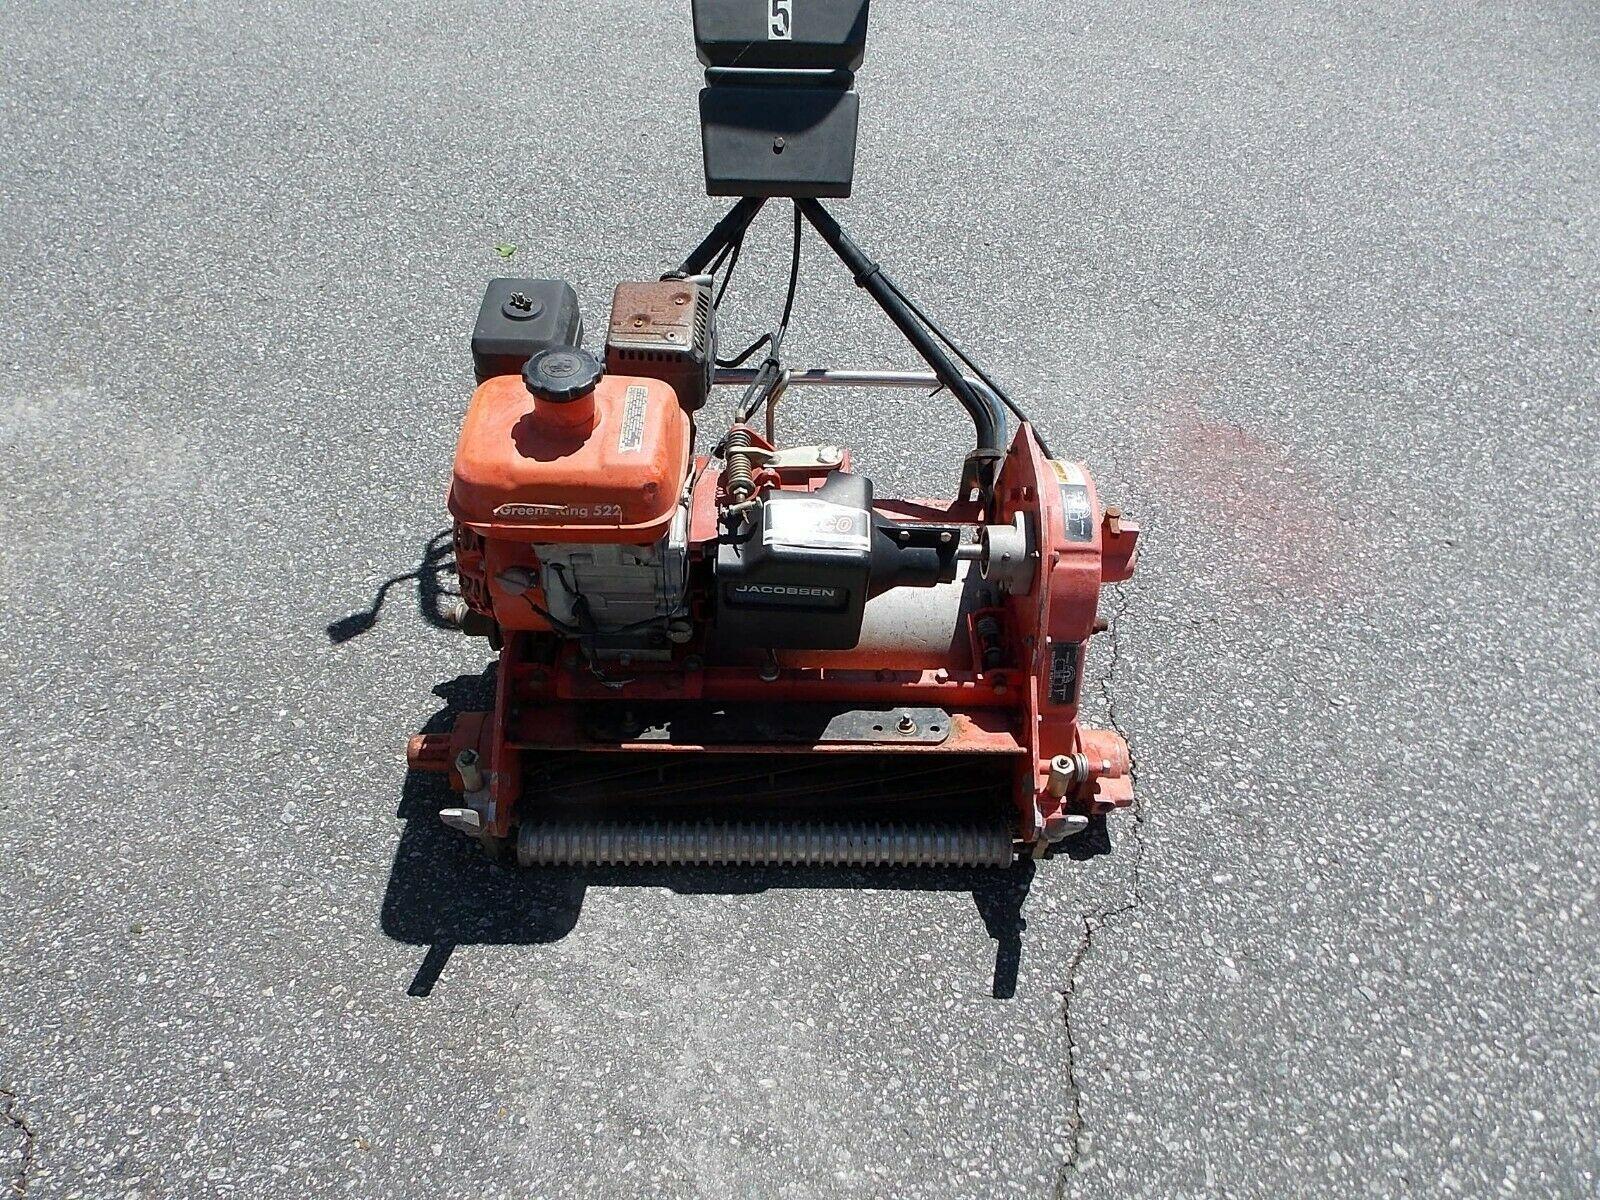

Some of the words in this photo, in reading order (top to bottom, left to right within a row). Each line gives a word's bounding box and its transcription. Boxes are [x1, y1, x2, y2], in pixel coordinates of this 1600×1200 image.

[772, 0, 790, 37] 5
[593, 504, 621, 516] 522
[736, 585, 835, 597] JACOBSEN
